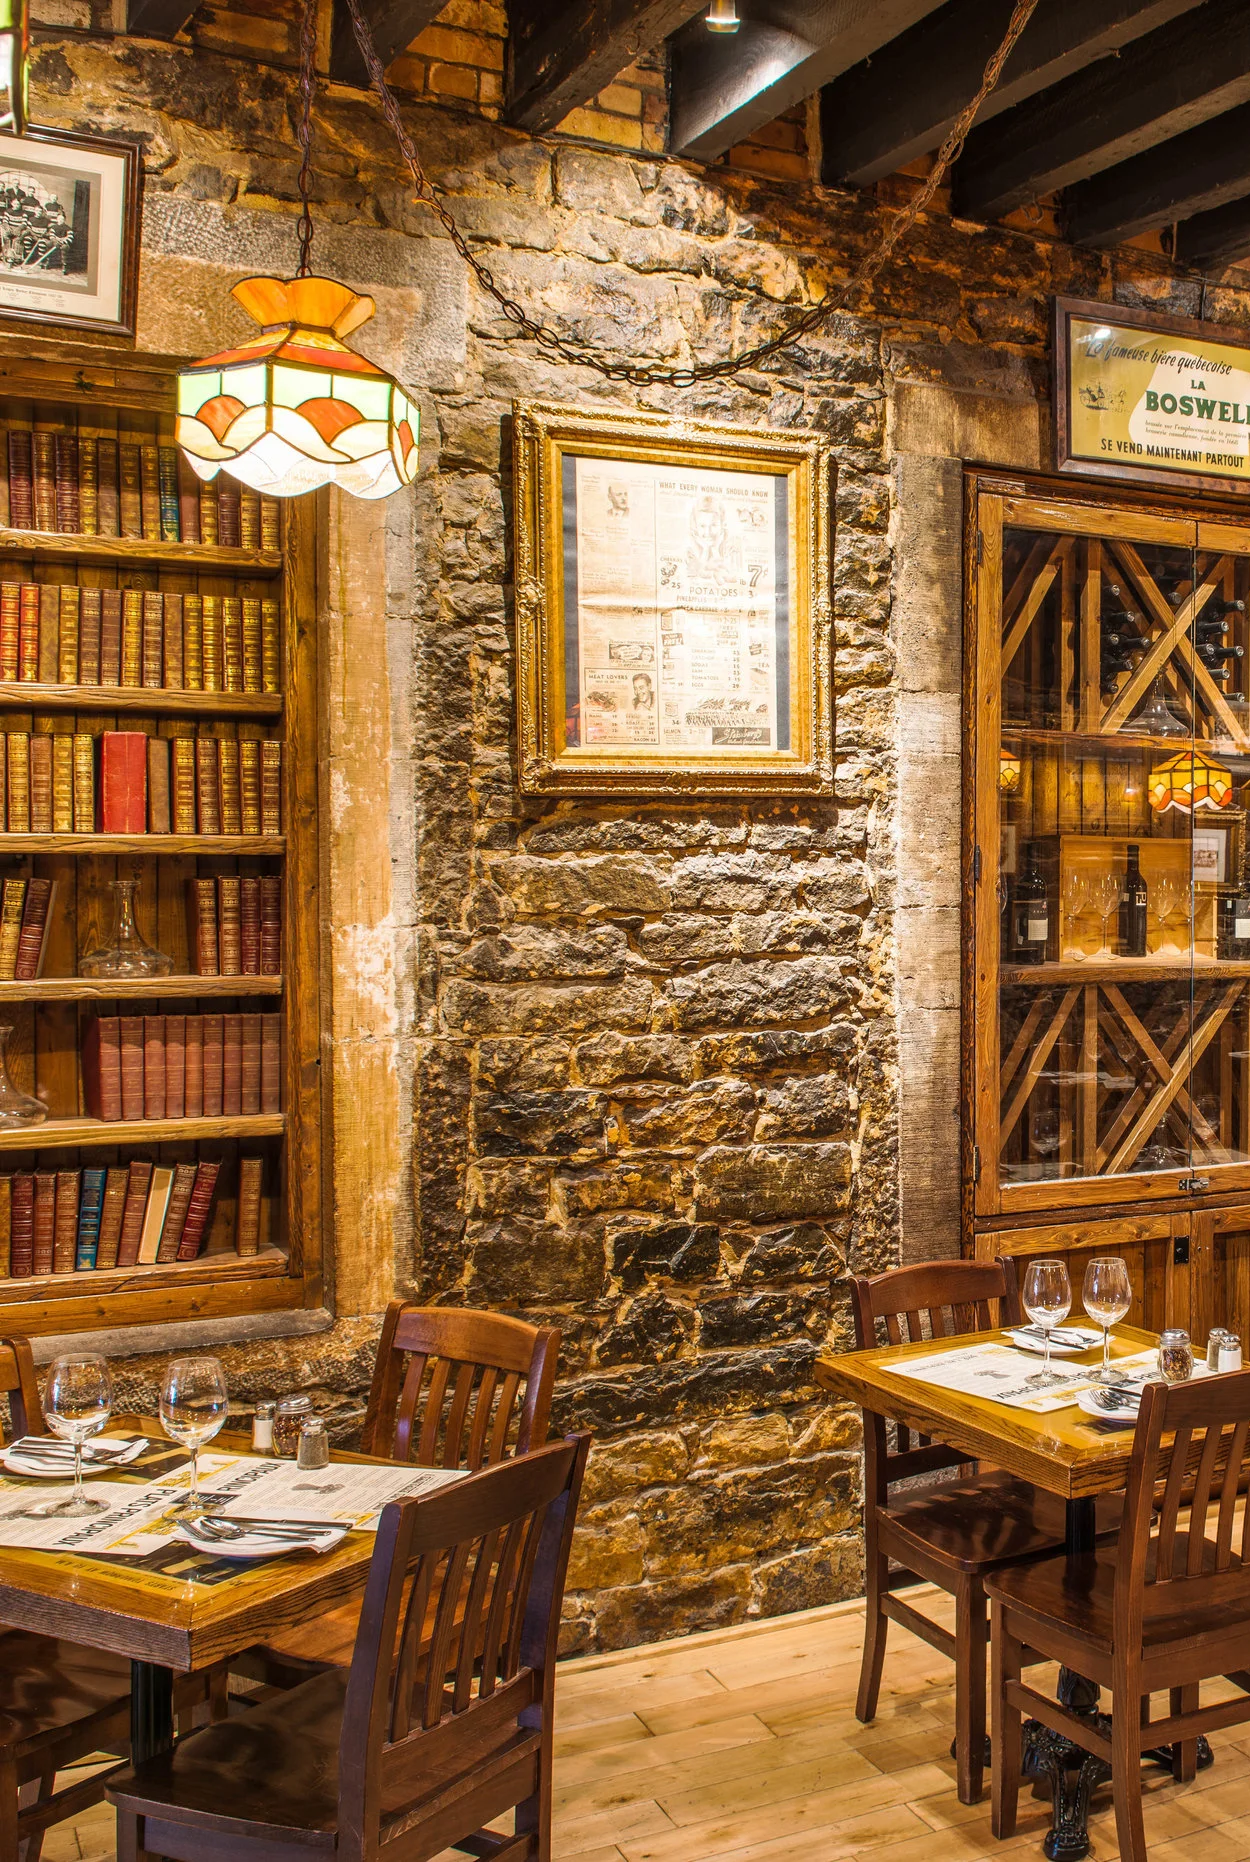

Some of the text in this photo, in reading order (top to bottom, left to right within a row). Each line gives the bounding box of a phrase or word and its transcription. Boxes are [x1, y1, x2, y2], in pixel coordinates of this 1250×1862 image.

[1105, 341, 1150, 362] fameuse
[1150, 349, 1176, 366] bière
[1191, 379, 1207, 391] LA
[1100, 438, 1245, 469] SE VEND MAINTENANT PARTOUT
[659, 481, 769, 498] WHAT EVERY WOMAN SHOULD KNOW
[690, 586, 738, 597] POTATOES
[127, 1488, 178, 1508] PLATS
[52, 1507, 143, 1547] PRINCIPAUX
